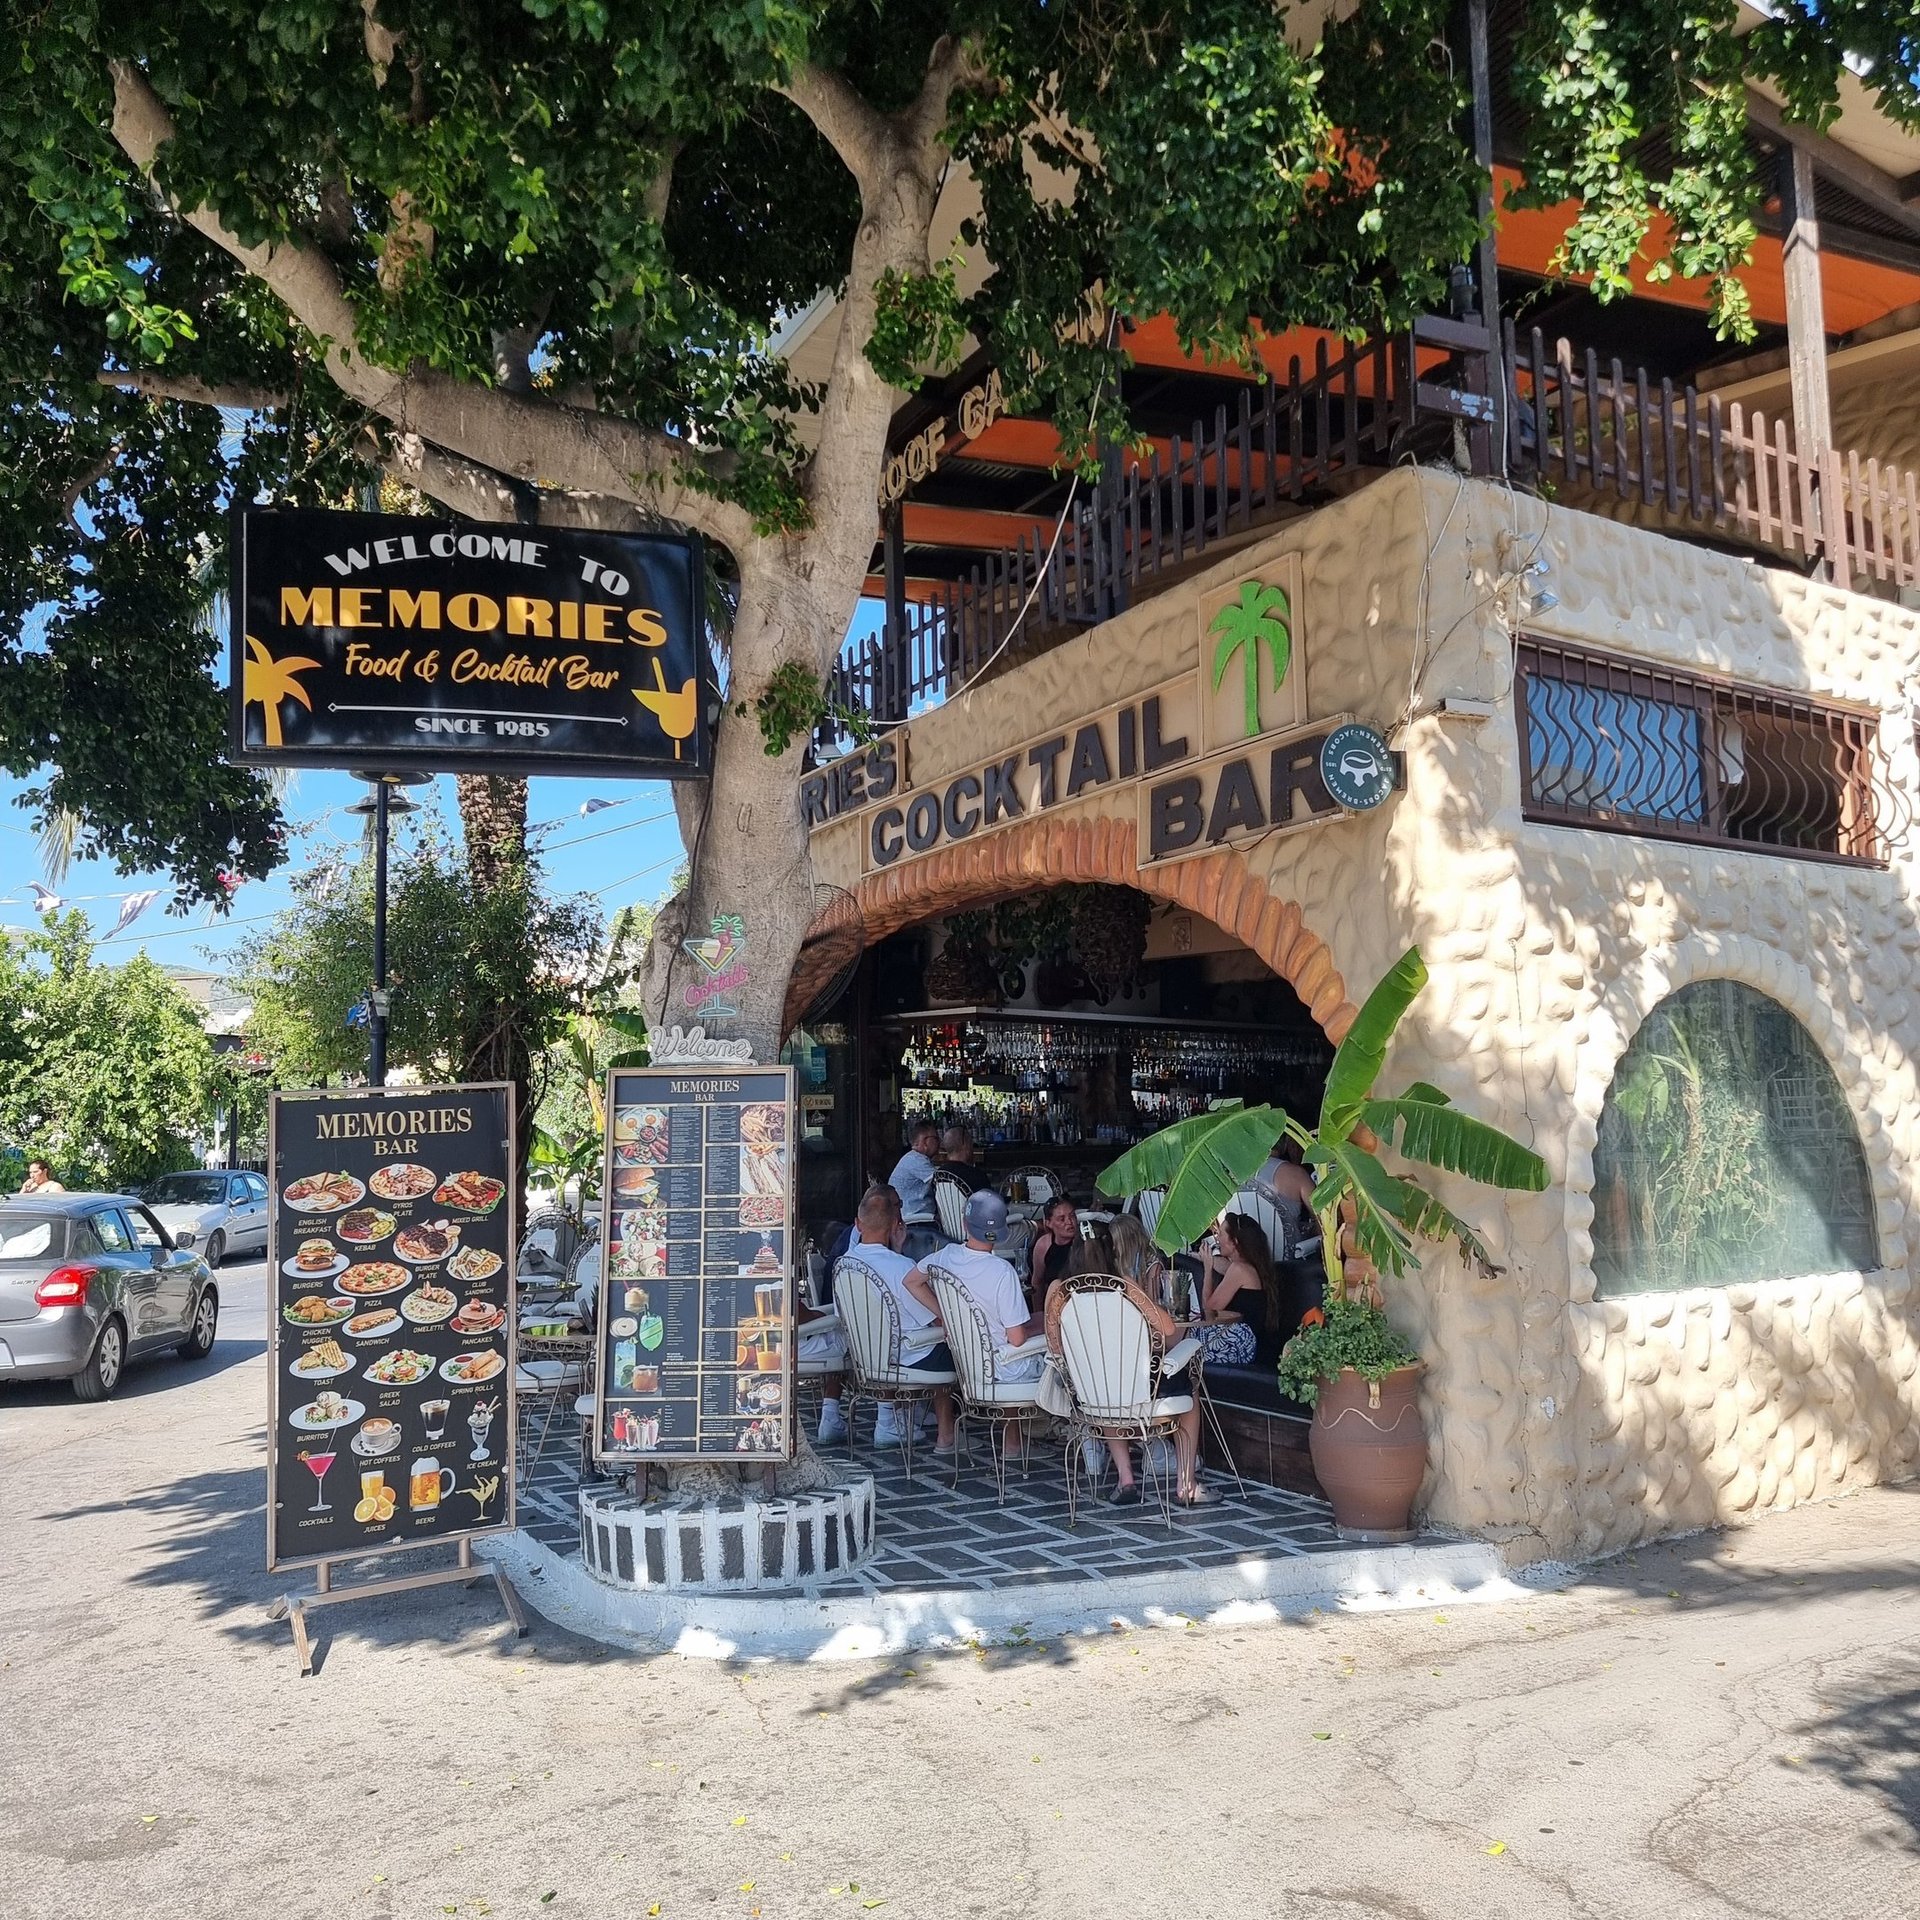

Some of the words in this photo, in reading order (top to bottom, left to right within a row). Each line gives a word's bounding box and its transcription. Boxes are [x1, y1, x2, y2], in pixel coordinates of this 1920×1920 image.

[324, 534, 547, 576] WELCOME
[579, 555, 630, 596] TO
[281, 586, 667, 647] MEMORIES
[346, 643, 410, 682] Food
[414, 652, 439, 683] &
[451, 648, 553, 689] Cocktail
[559, 655, 619, 690] Bar
[415, 717, 486, 735] SINCE
[494, 720, 550, 738] 1985
[871, 695, 1188, 867] COCKTAIL
[1150, 736, 1337, 854] BAR
[652, 1026, 747, 1058] Welcome
[670, 1080, 740, 1093] MEMORIES
[316, 1108, 472, 1139] MEMORIES
[374, 1139, 418, 1156] BAR
[298, 1218, 327, 1226] ENGLISH
[452, 1216, 470, 1224] MIXED
[472, 1215, 489, 1223] GRILL
[293, 1226, 332, 1235] BREAKFAST
[354, 1244, 376, 1252] KEBAB
[415, 1264, 440, 1272] BURGER
[418, 1272, 438, 1280] PLATE
[292, 1281, 324, 1290] BURGERS
[464, 1287, 494, 1296] SANDWICH
[302, 1328, 331, 1336] CHICKEN
[413, 1324, 445, 1333] OMELETTE
[301, 1336, 332, 1345] NUGGETS
[355, 1338, 390, 1347] SANDWICH
[461, 1336, 493, 1345] PANCAKES
[313, 1378, 334, 1386] TOAST
[451, 1386, 473, 1396] SPRING
[474, 1384, 494, 1392] ROLLS
[379, 1391, 400, 1399] GREEK
[379, 1399, 400, 1408] SALAD
[296, 1432, 329, 1442] BURRITOS
[412, 1444, 429, 1453] COLD
[429, 1441, 456, 1450] COFFEES
[360, 1458, 372, 1466] HOT
[373, 1455, 401, 1465] COFFEES
[466, 1462, 476, 1470] ICE
[477, 1460, 498, 1468] CREAM
[298, 1516, 334, 1527] COCKTAILS
[415, 1516, 436, 1525] BEERS
[363, 1524, 386, 1533] JUICES
